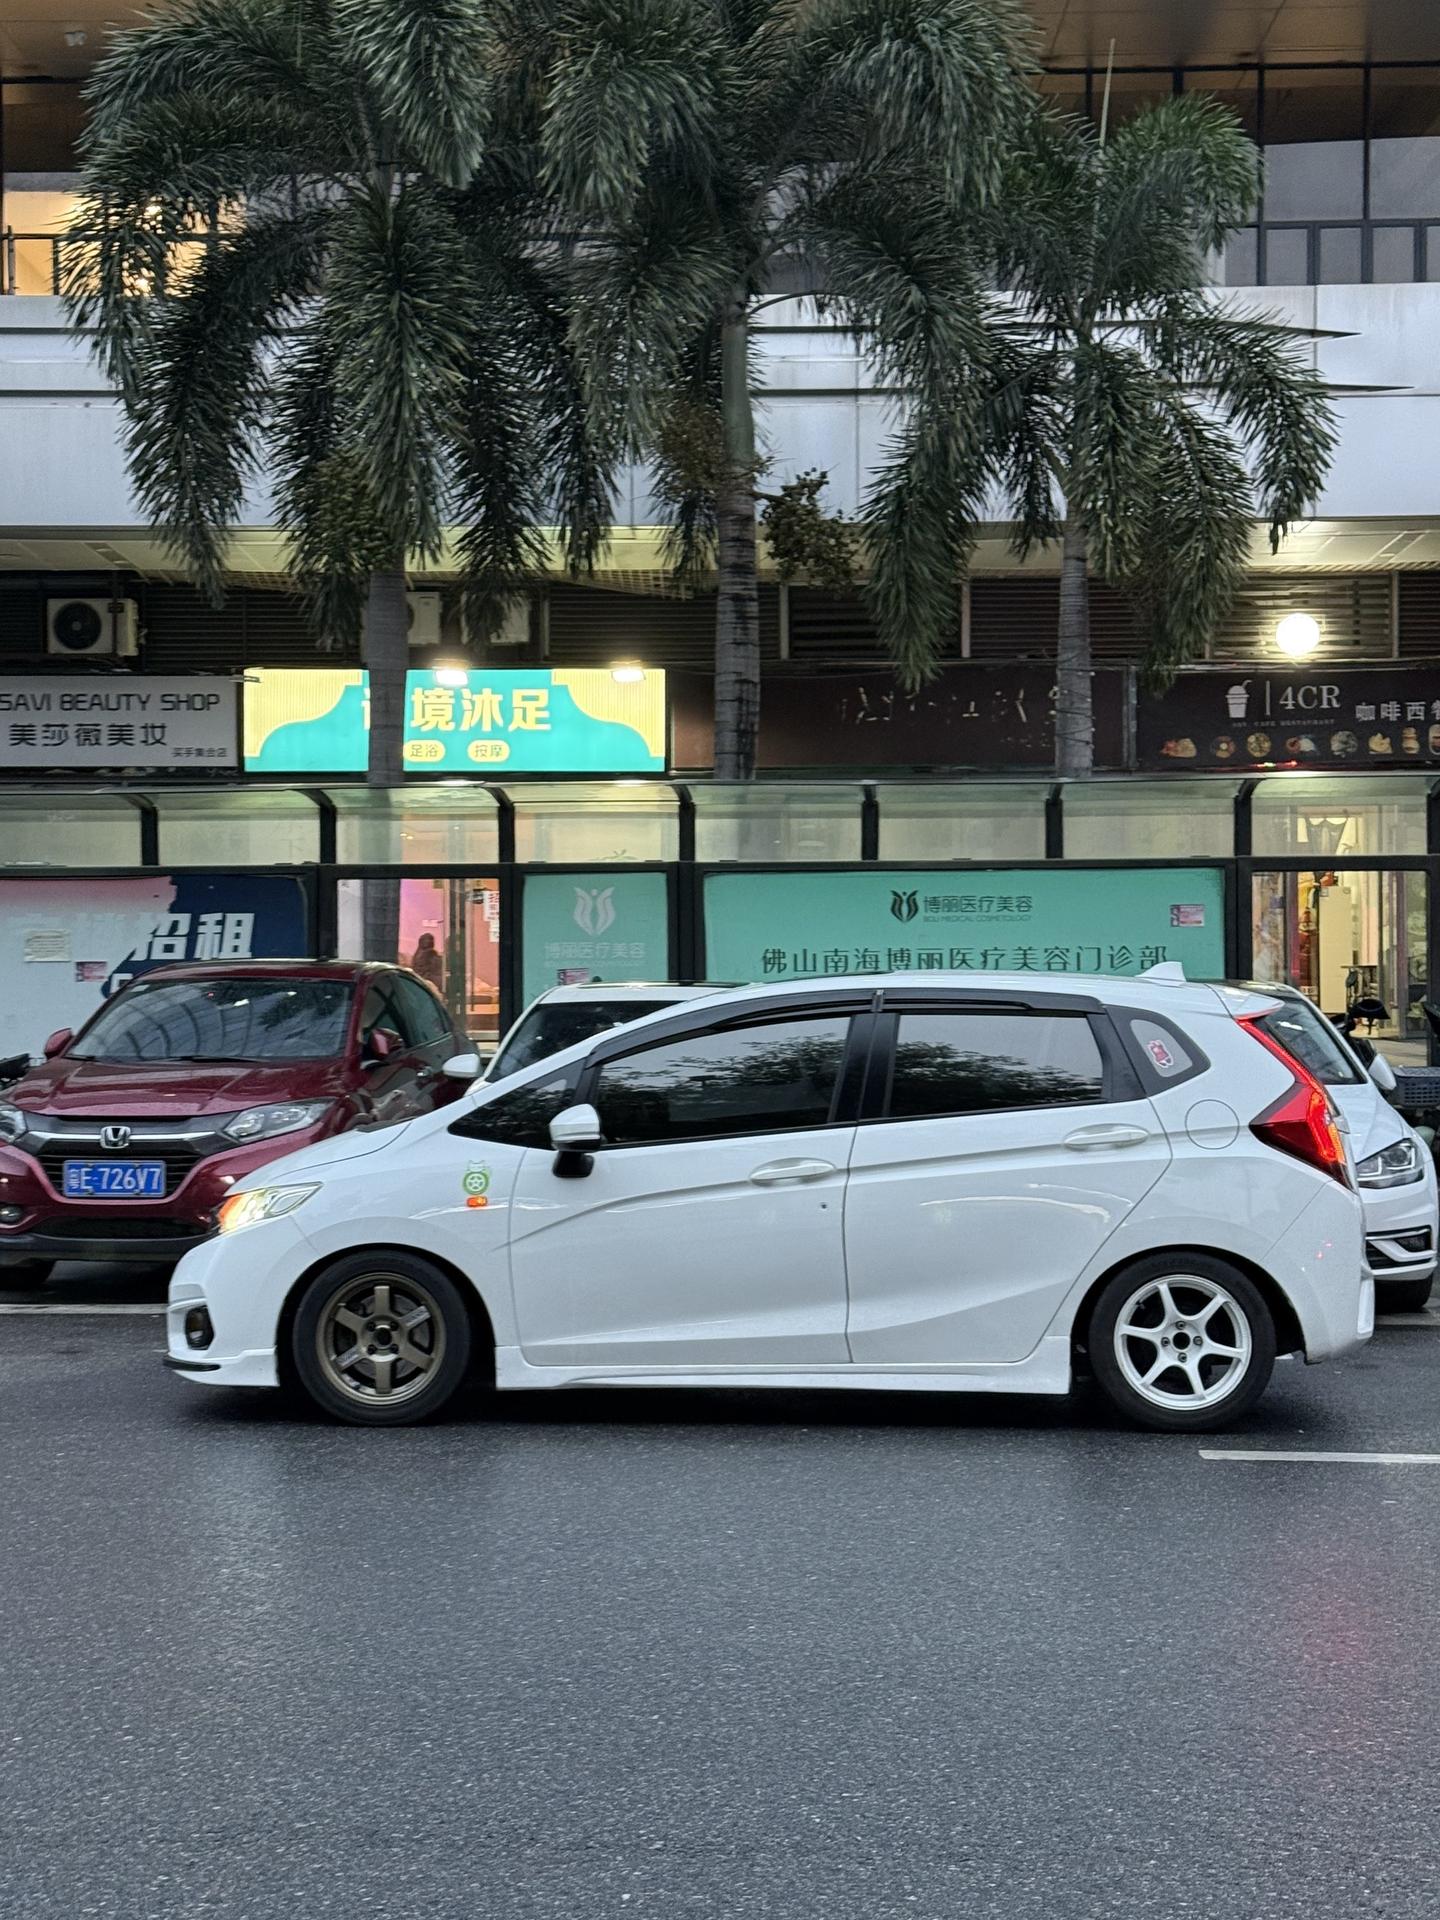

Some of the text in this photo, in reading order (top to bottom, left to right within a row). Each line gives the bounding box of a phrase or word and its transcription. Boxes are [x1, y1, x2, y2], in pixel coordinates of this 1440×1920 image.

[0, 693, 220, 711] SAVI BEAUTY SHOP
[1279, 685, 1341, 709] 4CR
[361, 687, 551, 732] 境沐足
[9, 723, 167, 747] 美莎薇美妆
[410, 743, 504, 758] 足浴 按摩
[923, 895, 1033, 914] 博丽医疗美容
[761, 945, 1168, 974] 佛山南海博丽医疗美容门诊部
